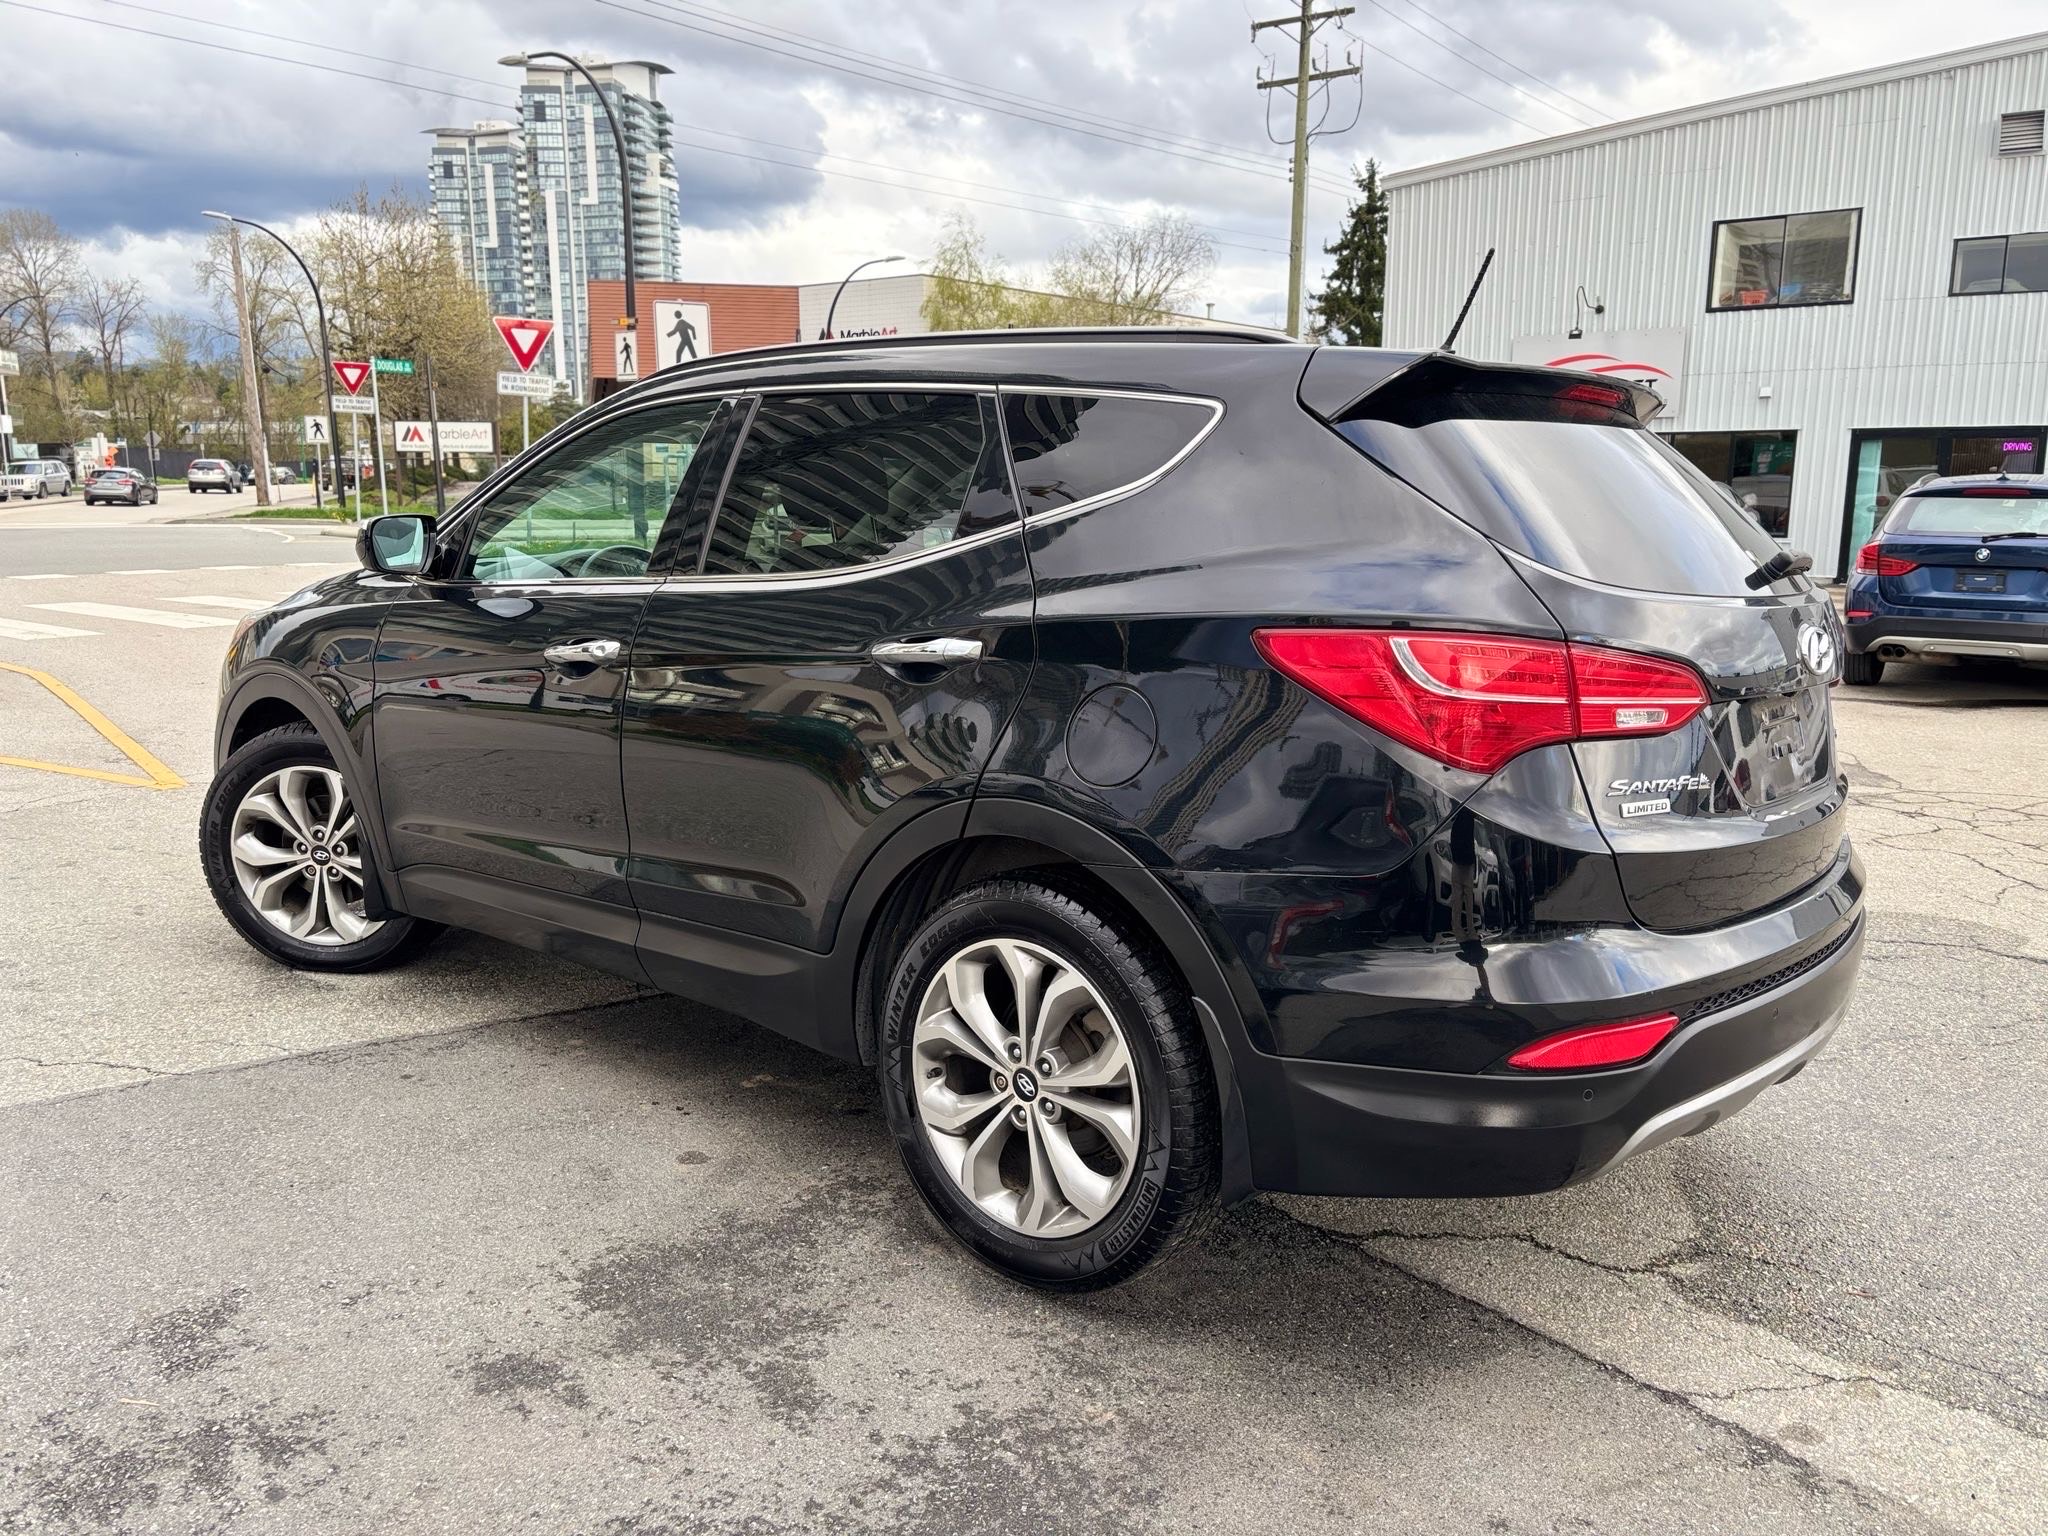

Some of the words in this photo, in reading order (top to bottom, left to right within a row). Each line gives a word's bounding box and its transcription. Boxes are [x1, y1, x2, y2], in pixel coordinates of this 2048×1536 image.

[377, 360, 403, 371] DOUGLAS
[511, 385, 550, 394] ROUNDABOUT
[2003, 442, 2032, 451] DRIVING
[1626, 802, 1668, 815] LIMITED
[887, 962, 918, 1041] WINTER
[1106, 1181, 1156, 1253] MOTOMASTER
